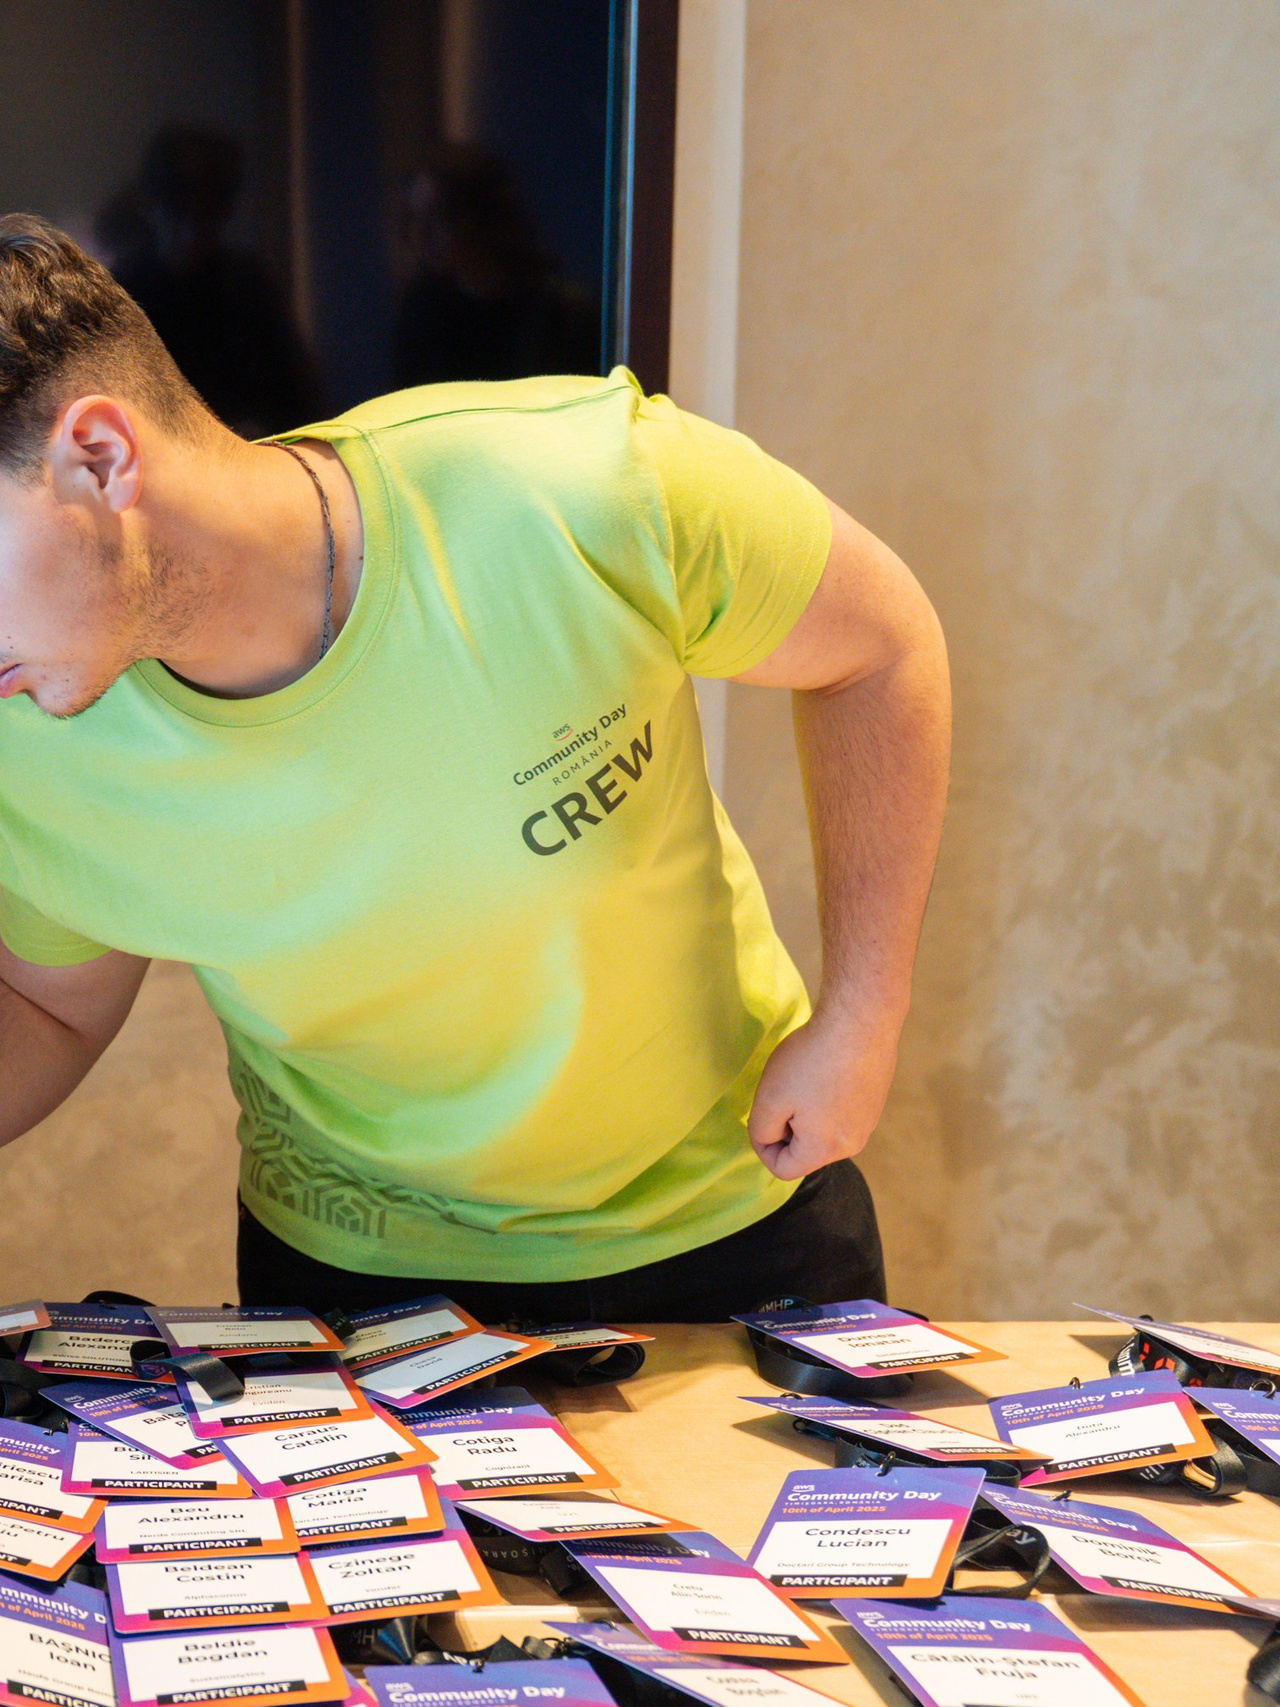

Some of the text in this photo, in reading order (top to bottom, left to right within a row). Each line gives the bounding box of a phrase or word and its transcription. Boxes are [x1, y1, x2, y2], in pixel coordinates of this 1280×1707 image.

[552, 723, 571, 739] aws
[513, 703, 627, 786] Community Day
[552, 739, 612, 786] ROMÂNIA
[521, 719, 653, 856] CREW
[765, 1299, 794, 1313] MHP
[764, 1313, 877, 1330] Community Day
[355, 1335, 441, 1361] PARTICIPANT
[848, 1338, 912, 1348] Ionatan
[879, 1354, 960, 1369] PARTICIPANT
[426, 1355, 508, 1391] PARTICIPANT
[74, 1386, 157, 1410] Community
[1002, 1387, 1145, 1417] Community Day
[234, 1410, 327, 1424] PARTICIPANT
[481, 1407, 513, 1415] Day
[274, 1425, 339, 1442] Caraus
[1065, 1425, 1122, 1438] Alexandru
[282, 1433, 348, 1450] Catalin
[452, 1436, 514, 1446] Cotiga
[467, 1446, 517, 1455] Radu
[1058, 1447, 1162, 1471] PARTICIPANT
[293, 1455, 388, 1482] PARTICIPANT
[485, 1463, 531, 1472] Cognizant
[104, 1480, 204, 1489] PARTICIPANT
[471, 1475, 568, 1488] PARTICIPANT
[302, 1486, 367, 1501] Cotiga
[787, 1490, 942, 1501] Community Day
[308, 1496, 364, 1508] Maria
[825, 1505, 854, 1514] April
[138, 1513, 244, 1524] Alexandru
[993, 1497, 1138, 1531] Community Day
[554, 1522, 646, 1533] PARTICIPANT
[805, 1527, 912, 1536] Condescu
[143, 1540, 249, 1552] PARTICIPANT
[817, 1539, 888, 1547] Lucian
[1072, 1535, 1163, 1557] Dominik
[675, 1547, 710, 1558] Day
[1099, 1549, 1162, 1565] Boros
[164, 1563, 253, 1573] Beldean
[328, 1552, 416, 1570] Czinege
[176, 1573, 245, 1583] Costin
[341, 1563, 411, 1579] Zoltan
[781, 1577, 893, 1586] PARTICIPANT
[1119, 1579, 1223, 1602] PARTICIPANT
[333, 1593, 445, 1614] PARTICIPANT
[163, 1604, 275, 1619] PARTICIPANT
[863, 1618, 1032, 1633] Community Day
[184, 1640, 256, 1651] Beldie
[689, 1630, 792, 1646] PARTICIPANT
[49, 1651, 96, 1672] Ioan
[177, 1650, 269, 1664] Bogdan
[976, 1667, 1039, 1681] Fruja
[172, 1683, 292, 1704] PARTICIPANT
[390, 1686, 565, 1703] Community Day
